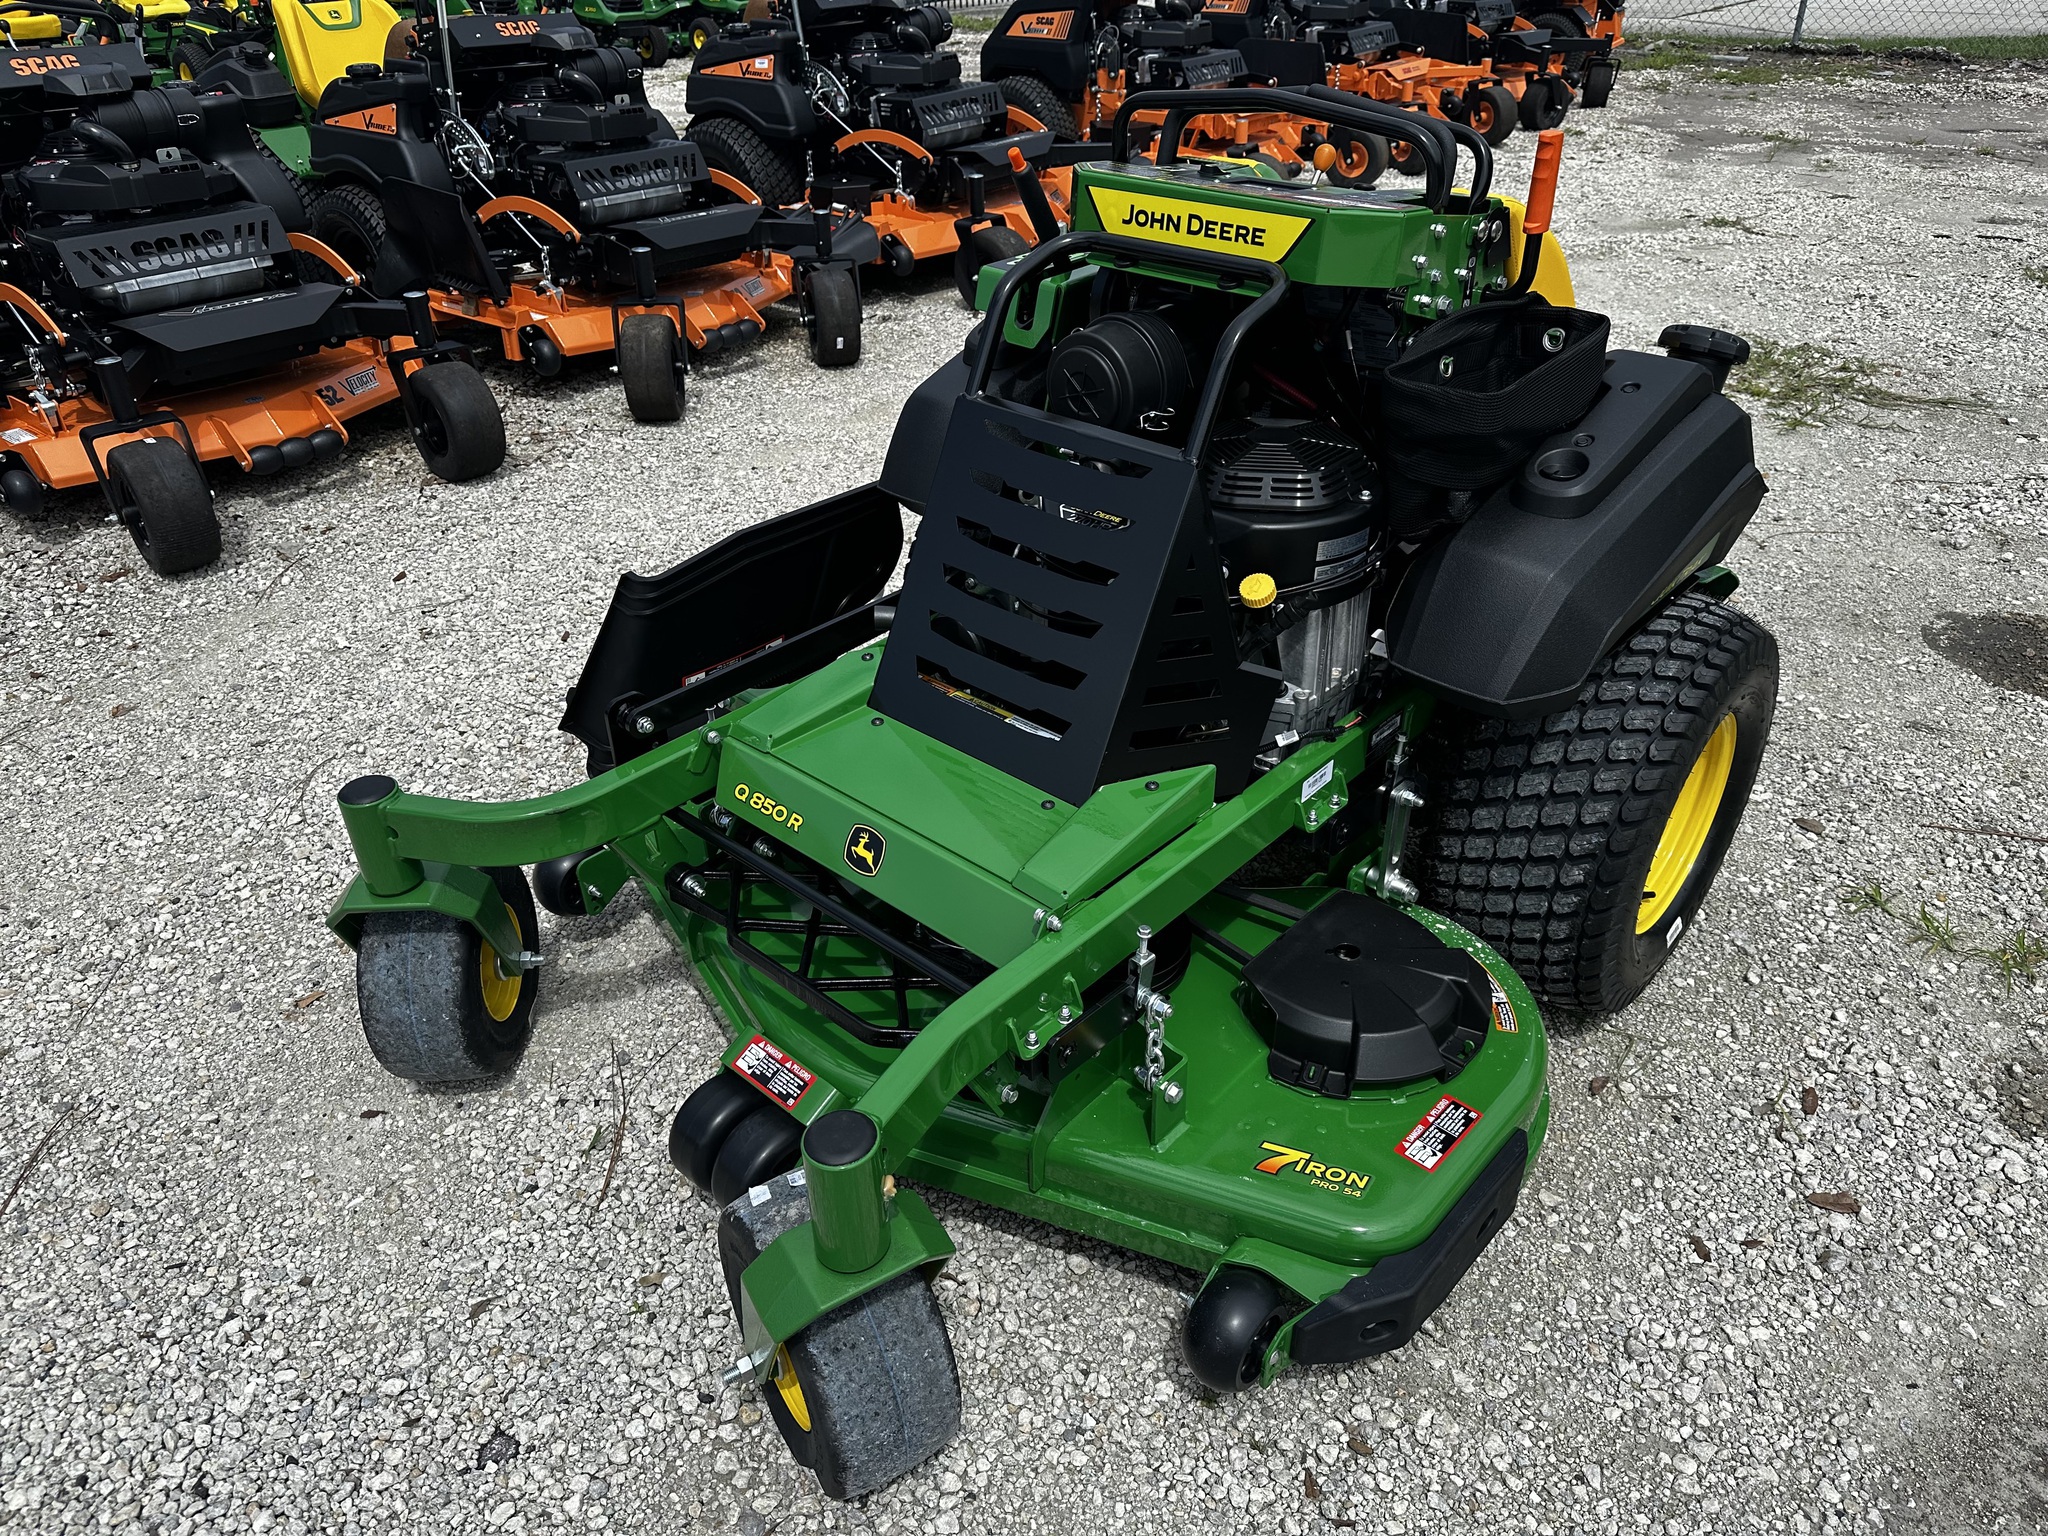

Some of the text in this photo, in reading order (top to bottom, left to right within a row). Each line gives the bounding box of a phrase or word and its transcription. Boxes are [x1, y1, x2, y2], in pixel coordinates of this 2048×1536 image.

[495, 20, 541, 36] SCAG
[1036, 16, 1055, 26] SCAG
[9, 53, 81, 76] SCAG
[609, 157, 673, 190] SCAG
[1121, 204, 1267, 248] JOHN DEERE
[130, 228, 231, 271] SCAG
[314, 384, 346, 407] 52
[1092, 510, 1123, 523] DEERE
[763, 1043, 784, 1061] DANGER
[790, 1063, 812, 1081] PELIGRO
[1429, 1098, 1450, 1117] PELIGRO
[1405, 1123, 1426, 1143] DANGER
[1310, 1178, 1363, 1199] PRO 54
